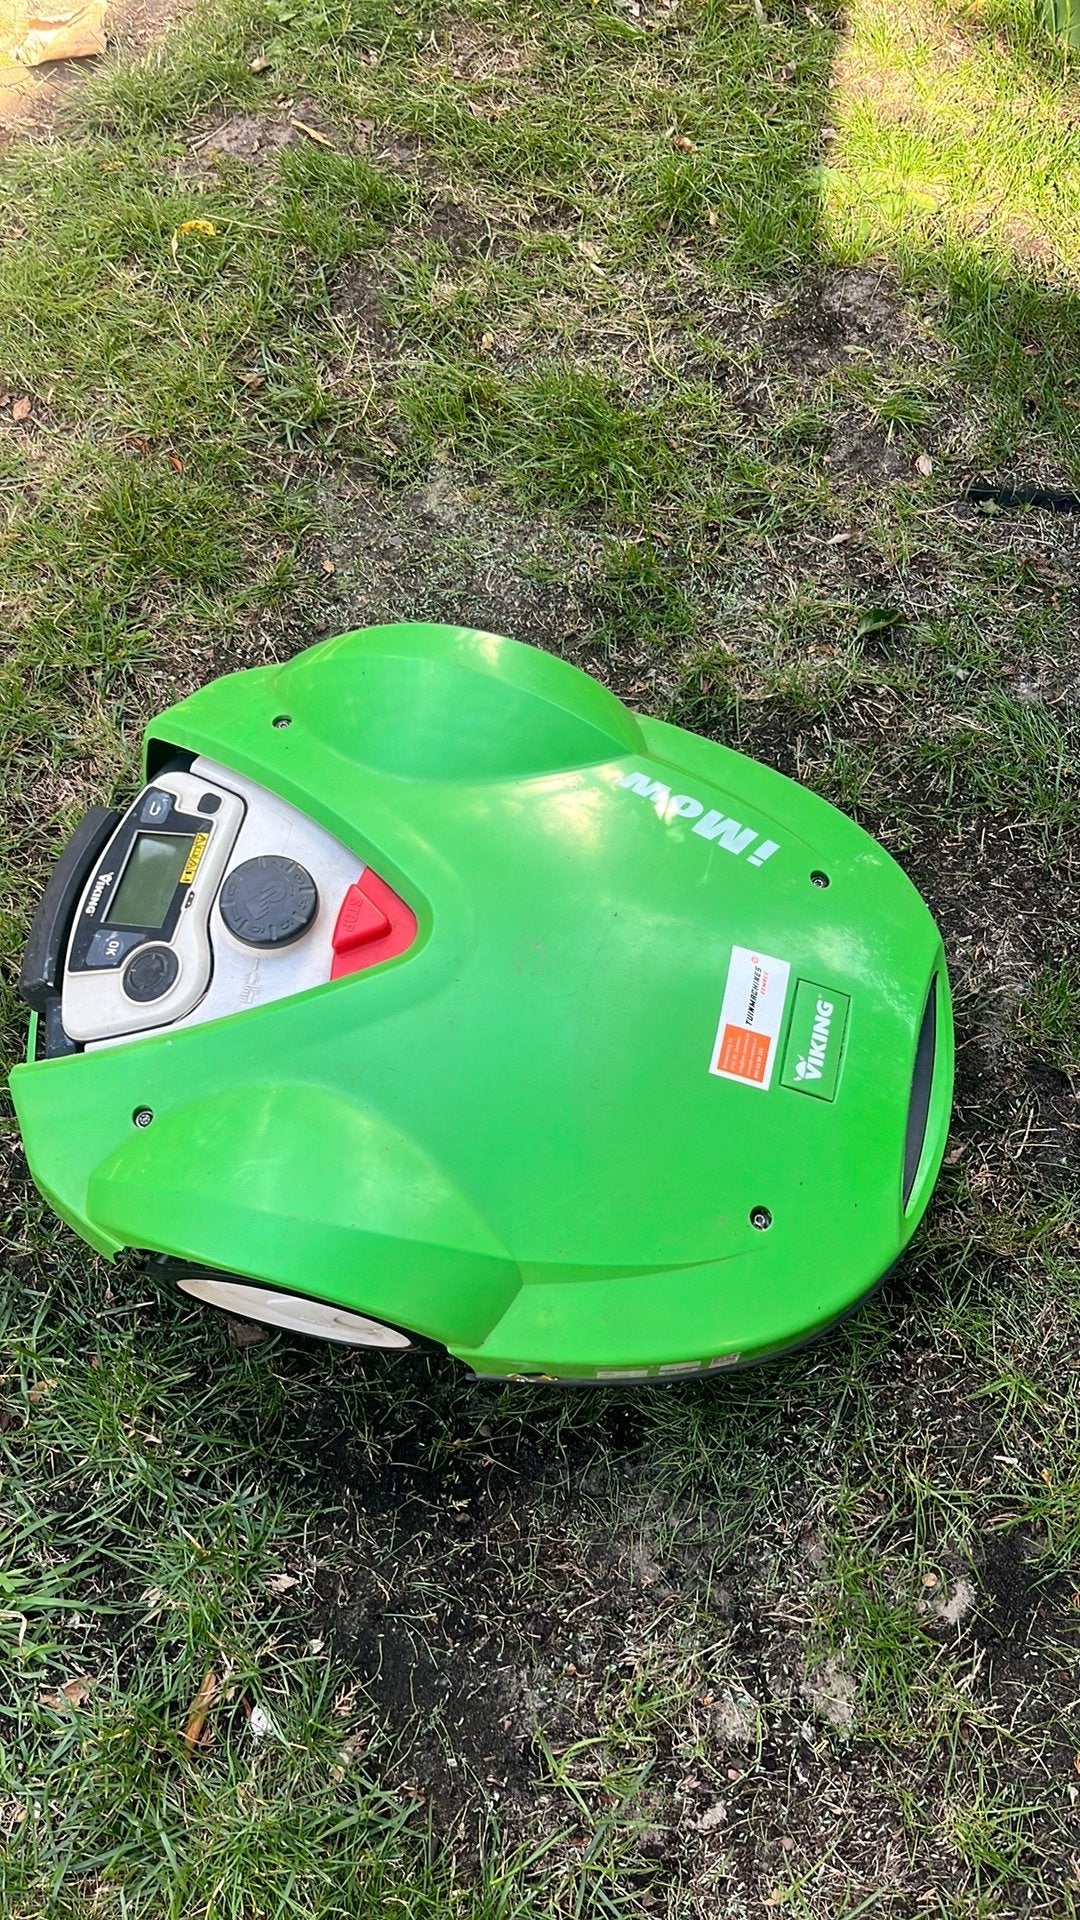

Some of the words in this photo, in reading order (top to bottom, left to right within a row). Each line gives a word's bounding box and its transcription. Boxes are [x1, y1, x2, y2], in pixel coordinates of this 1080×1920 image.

[85, 873, 110, 914] VIKING
[342, 897, 363, 932] STOP
[105, 941, 120, 956] OK
[745, 965, 762, 1026] TUINMACHINES
[805, 999, 834, 1080] VIKING
